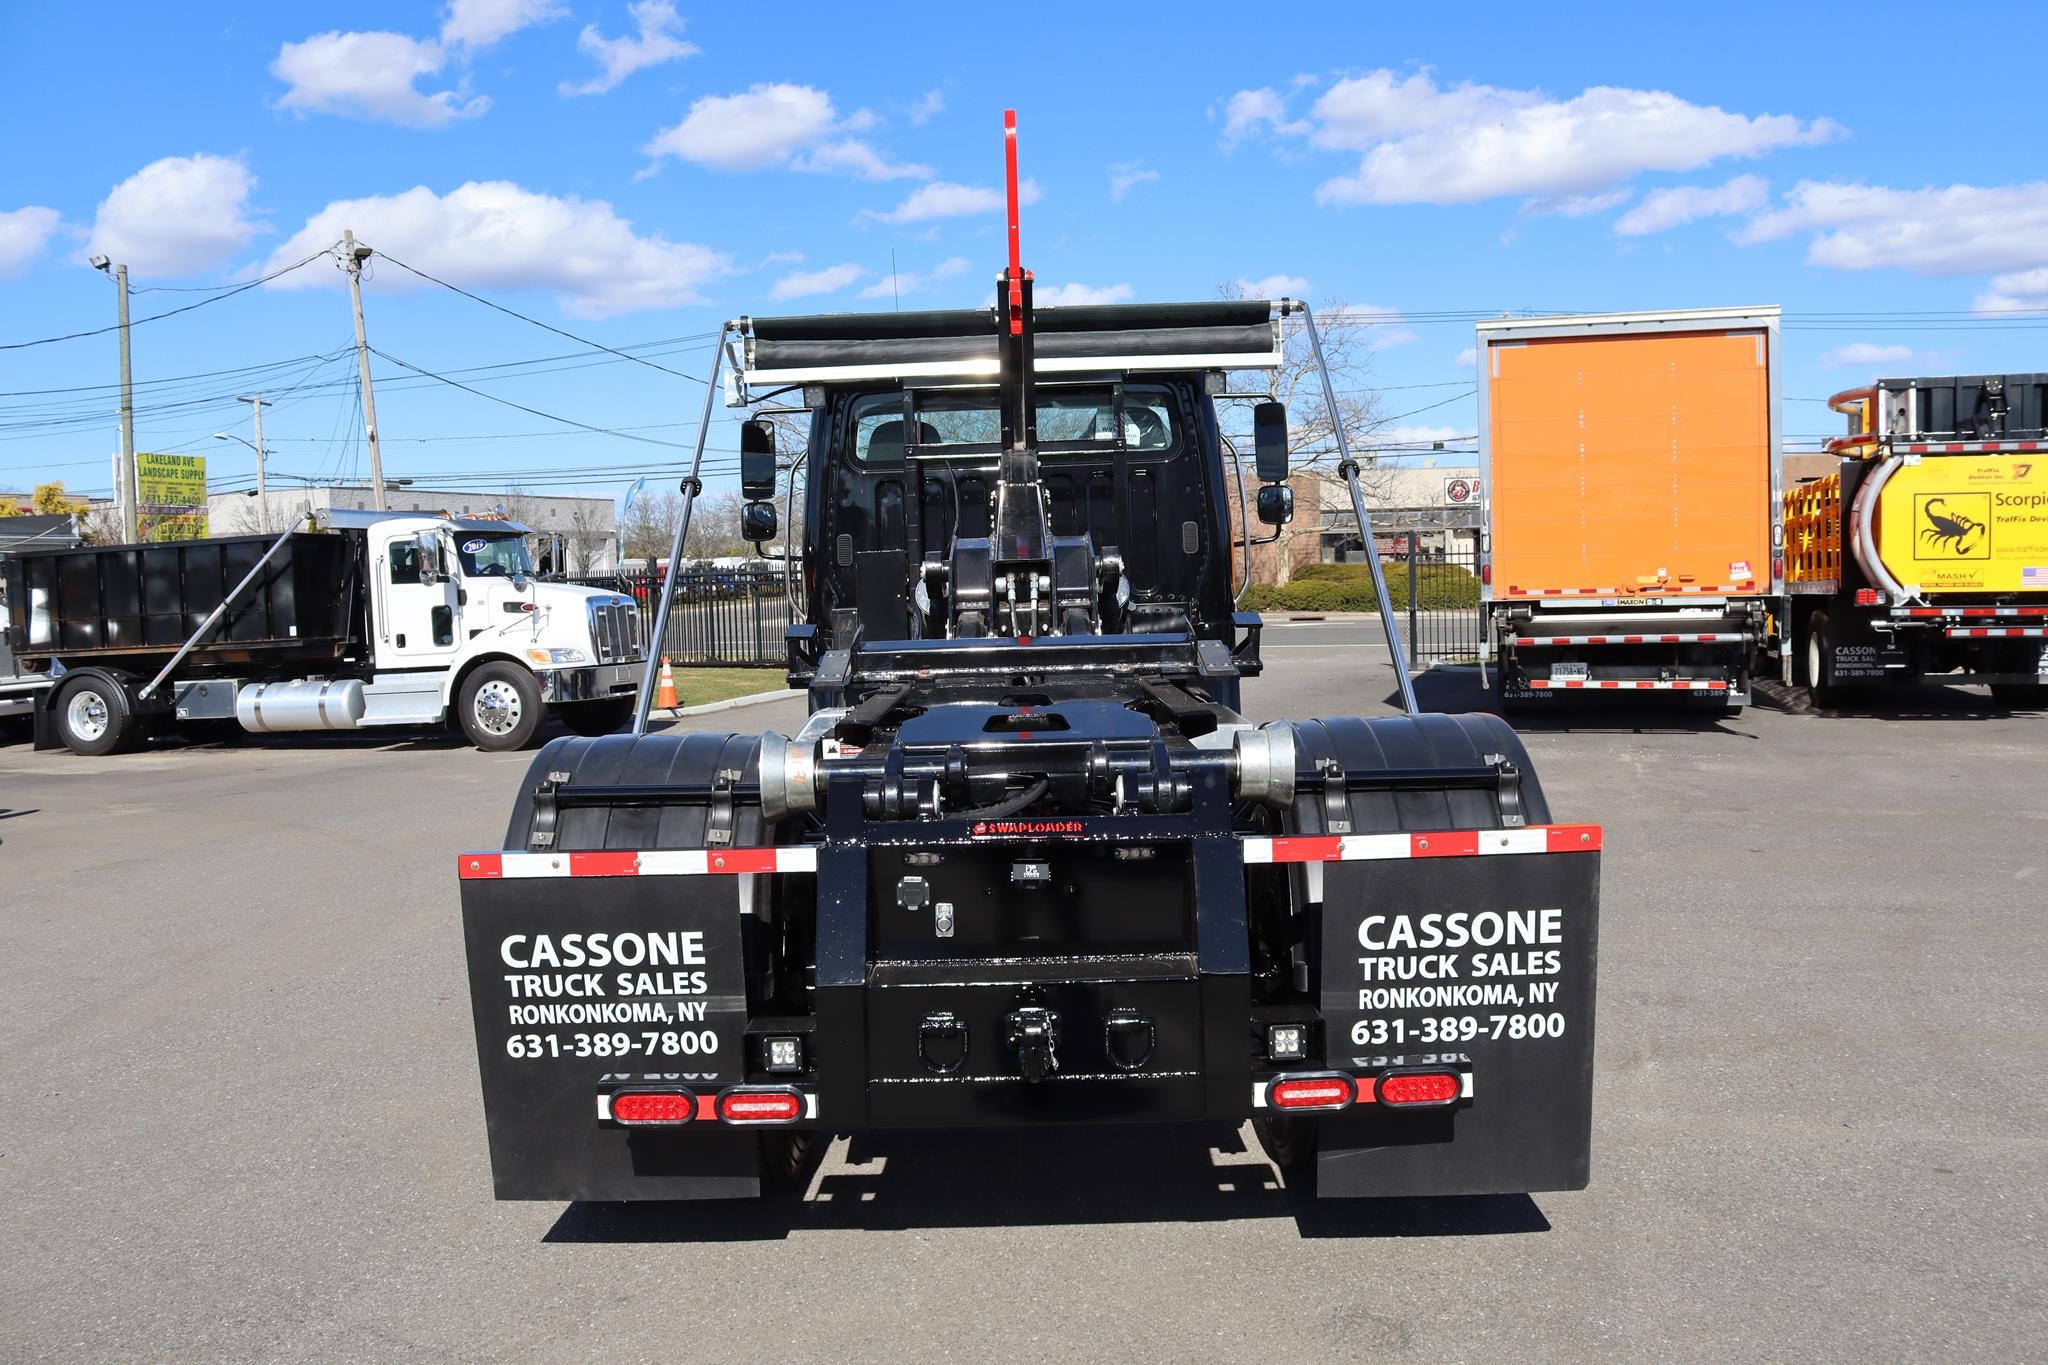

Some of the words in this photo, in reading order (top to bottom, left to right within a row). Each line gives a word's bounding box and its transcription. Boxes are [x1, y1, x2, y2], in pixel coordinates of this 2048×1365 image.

[139, 467, 179, 478] LANDSCAPE
[181, 470, 204, 480] SUPPLY
[147, 454, 180, 466] LAKELAND
[183, 456, 195, 467] AVE
[1996, 492, 2048, 508] Scorpi
[1836, 647, 1876, 655] CASSON
[989, 822, 1081, 833] SWAPLOADER
[1357, 908, 1563, 951] CASSONE
[500, 931, 706, 969] CASSONE
[1358, 954, 1459, 981] TRUCK
[1471, 950, 1561, 978] SALES
[504, 973, 605, 998] TRUCK
[616, 971, 708, 997] SALES
[1358, 983, 1525, 1010] RONKONKOMA,
[1529, 981, 1560, 1004] NY
[509, 1001, 674, 1027] RONKONKOMA,
[678, 1000, 709, 1022] NY
[1351, 1012, 1566, 1046] 631-389-7800
[506, 1030, 719, 1059] 631-389-7800
